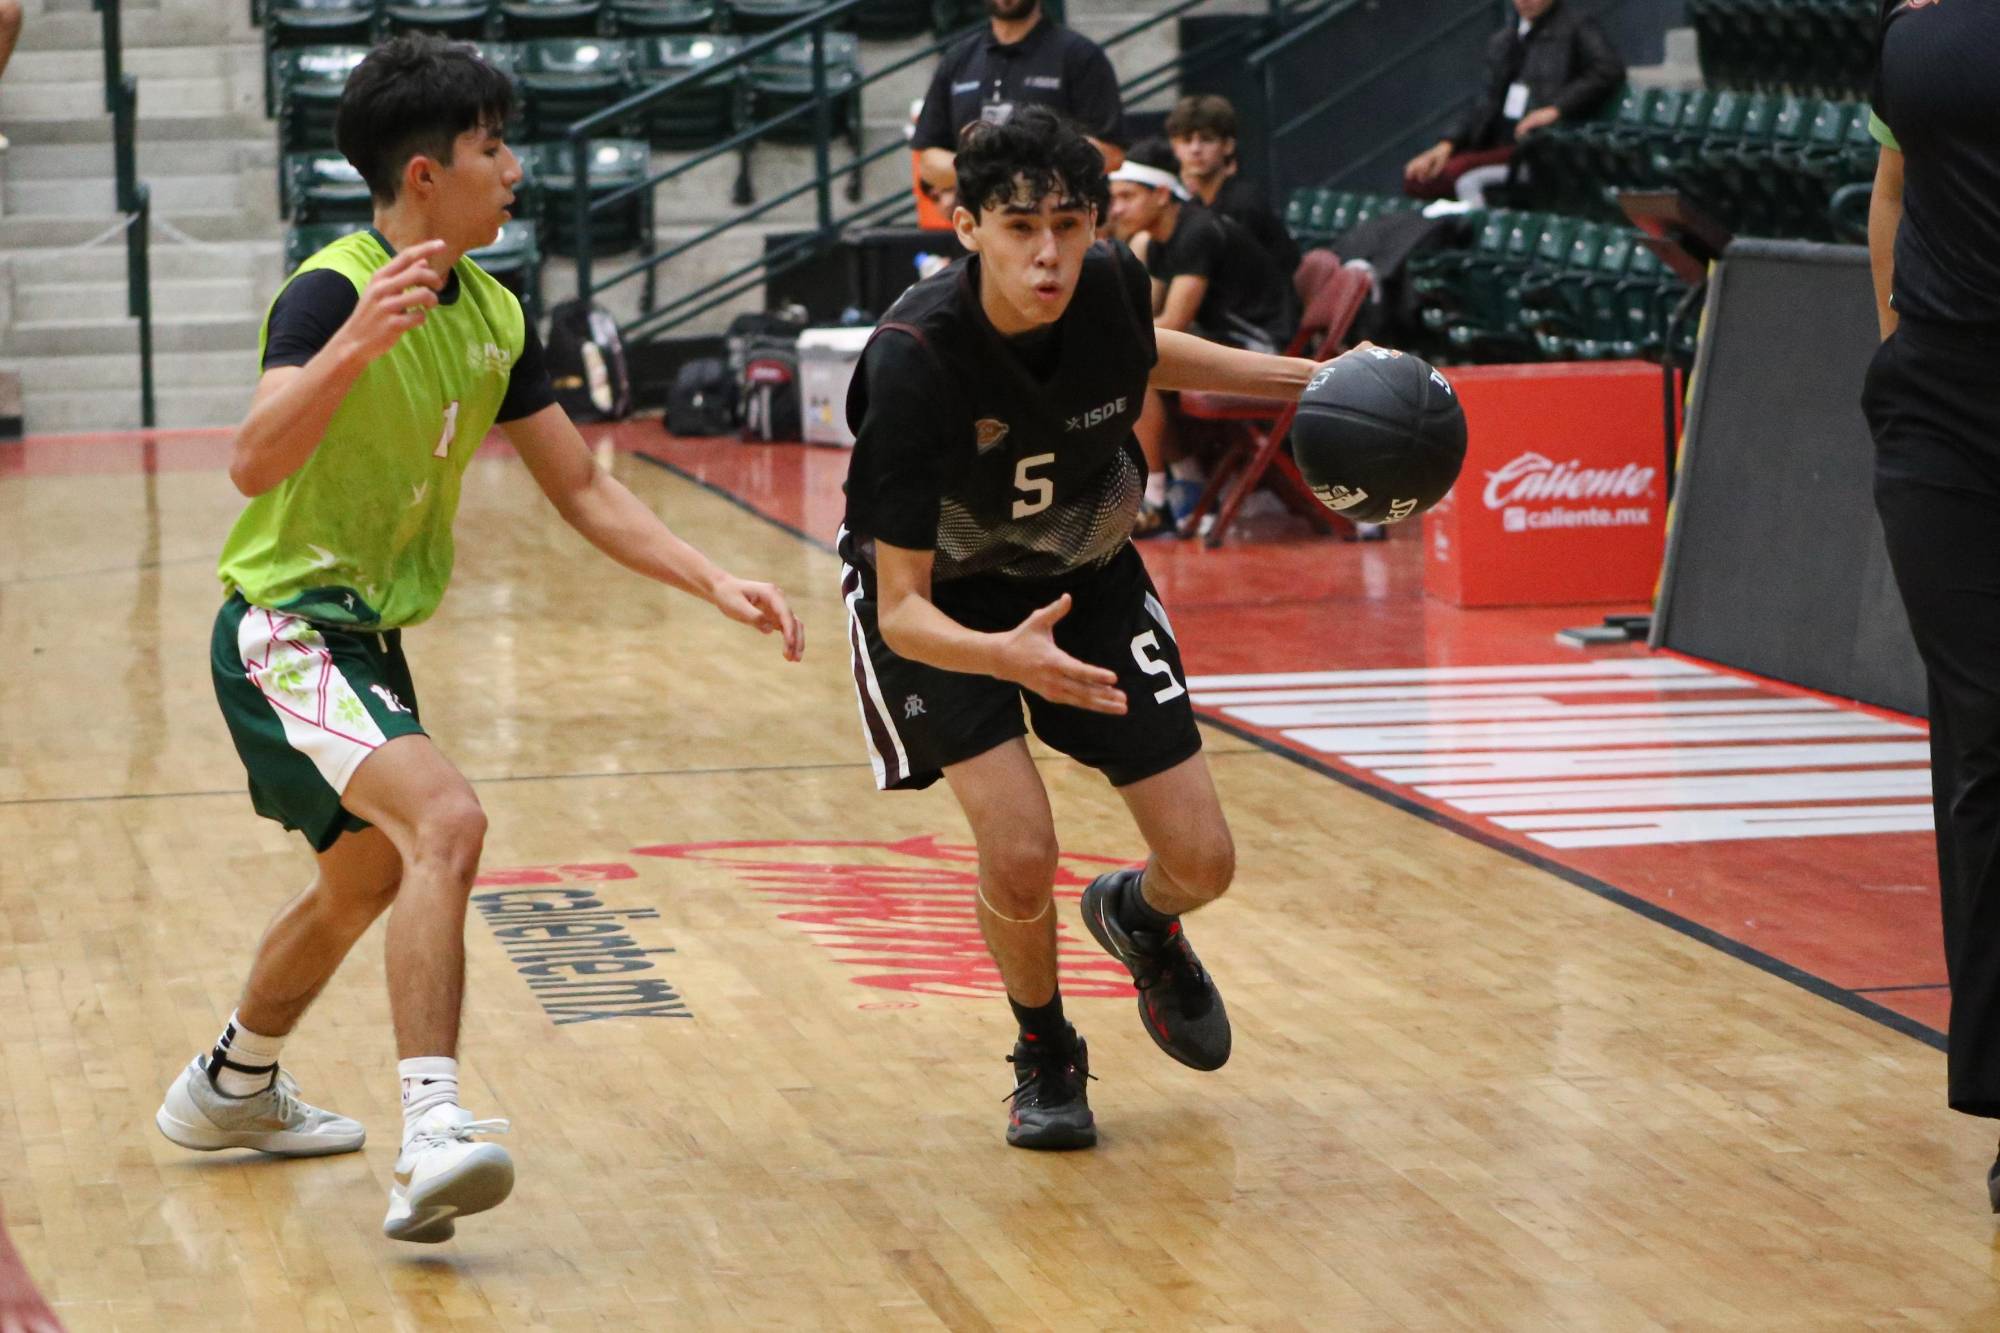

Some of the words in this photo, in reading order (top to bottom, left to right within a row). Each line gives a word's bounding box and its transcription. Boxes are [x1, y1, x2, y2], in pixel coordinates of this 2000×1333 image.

[432, 400, 459, 458] 1
[1084, 397, 1127, 428] ISDE
[1012, 452, 1055, 520] 5
[1483, 452, 1655, 510] Caliente
[1525, 506, 1650, 529] caliente.mx
[1130, 629, 1186, 705] 5
[470, 889, 694, 1025] caliente.mx
